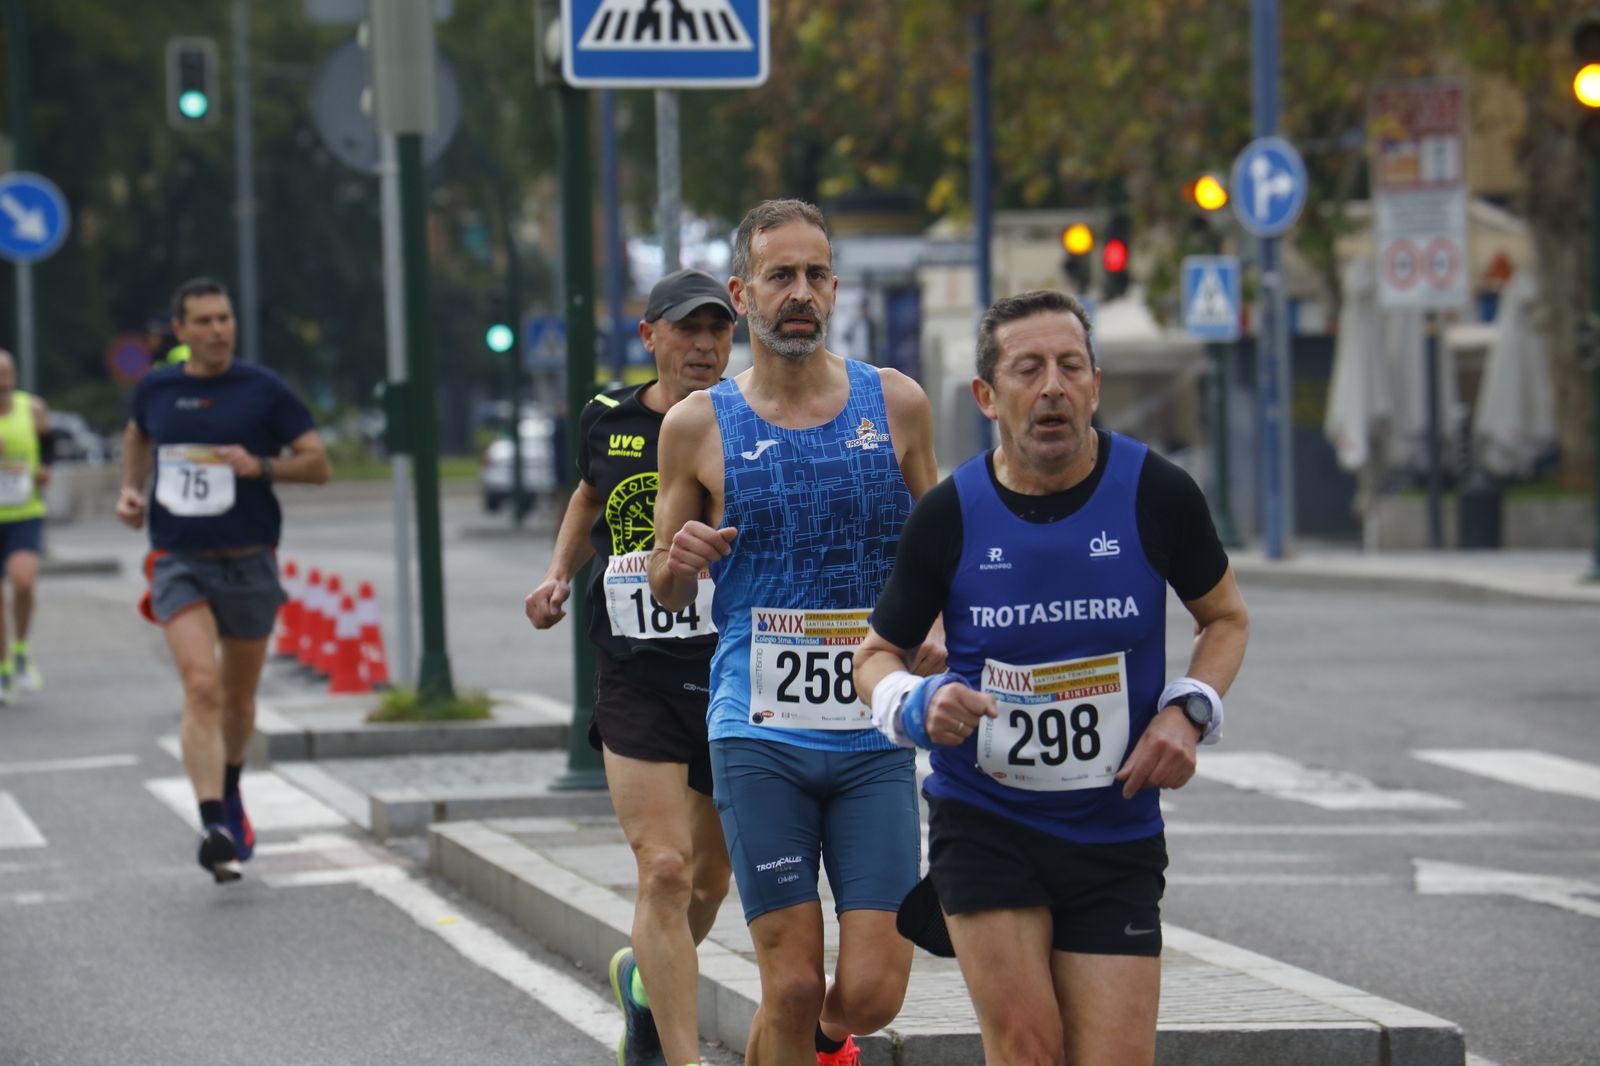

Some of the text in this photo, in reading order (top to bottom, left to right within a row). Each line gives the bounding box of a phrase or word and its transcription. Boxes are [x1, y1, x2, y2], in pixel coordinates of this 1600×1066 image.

[609, 434, 645, 450] uve
[179, 468, 209, 500] 75
[1089, 531, 1121, 557] als
[609, 556, 646, 574] XXXIX
[630, 587, 700, 634] 184
[969, 596, 1140, 627] TROTASIERRA
[757, 613, 804, 633] XXXIX
[755, 635, 777, 644] Colegio
[795, 637, 820, 645] Trinidad
[777, 650, 858, 704] 258
[987, 664, 1033, 692] XXXIX
[1068, 669, 1097, 679] TRINIDAD
[1057, 682, 1121, 700] TRINITARIOS
[1007, 702, 1101, 767] 298
[756, 856, 802, 872] TROTACALLES
